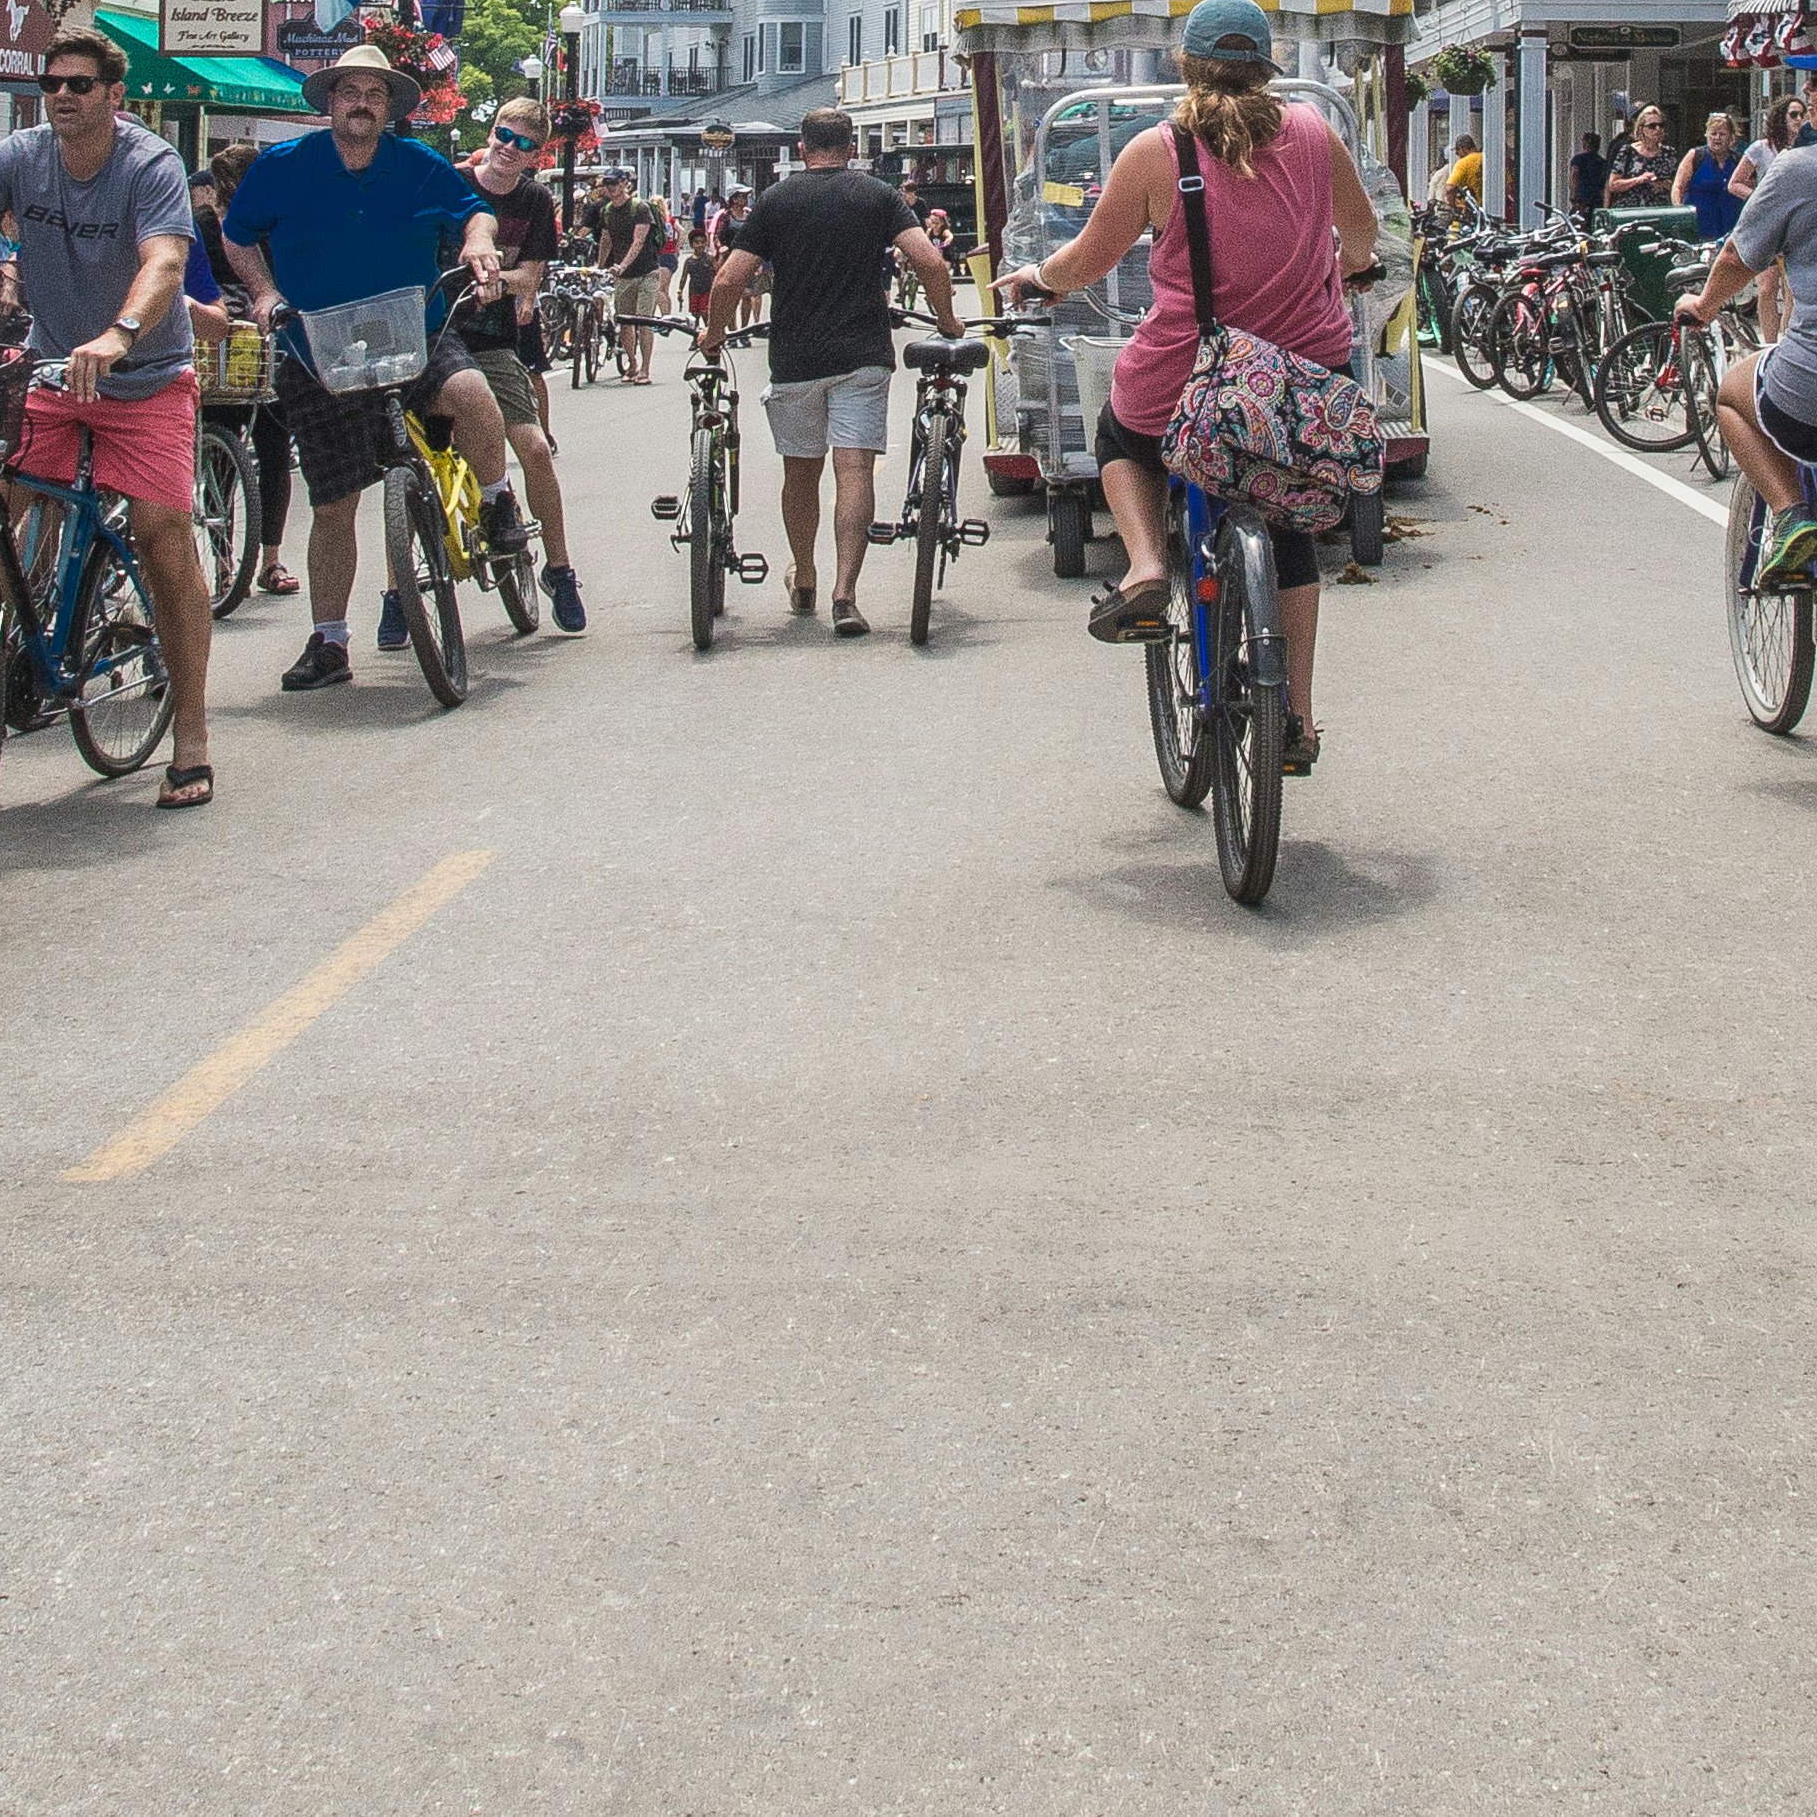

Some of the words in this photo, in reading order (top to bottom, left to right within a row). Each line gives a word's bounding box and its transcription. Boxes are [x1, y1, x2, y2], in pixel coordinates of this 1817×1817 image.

[170, 8, 212, 22] Island
[211, 7, 259, 22] Breeze
[177, 30, 201, 44] Fine
[202, 30, 219, 42] Art
[219, 30, 250, 43] Gallery
[295, 48, 345, 56] POTTERY
